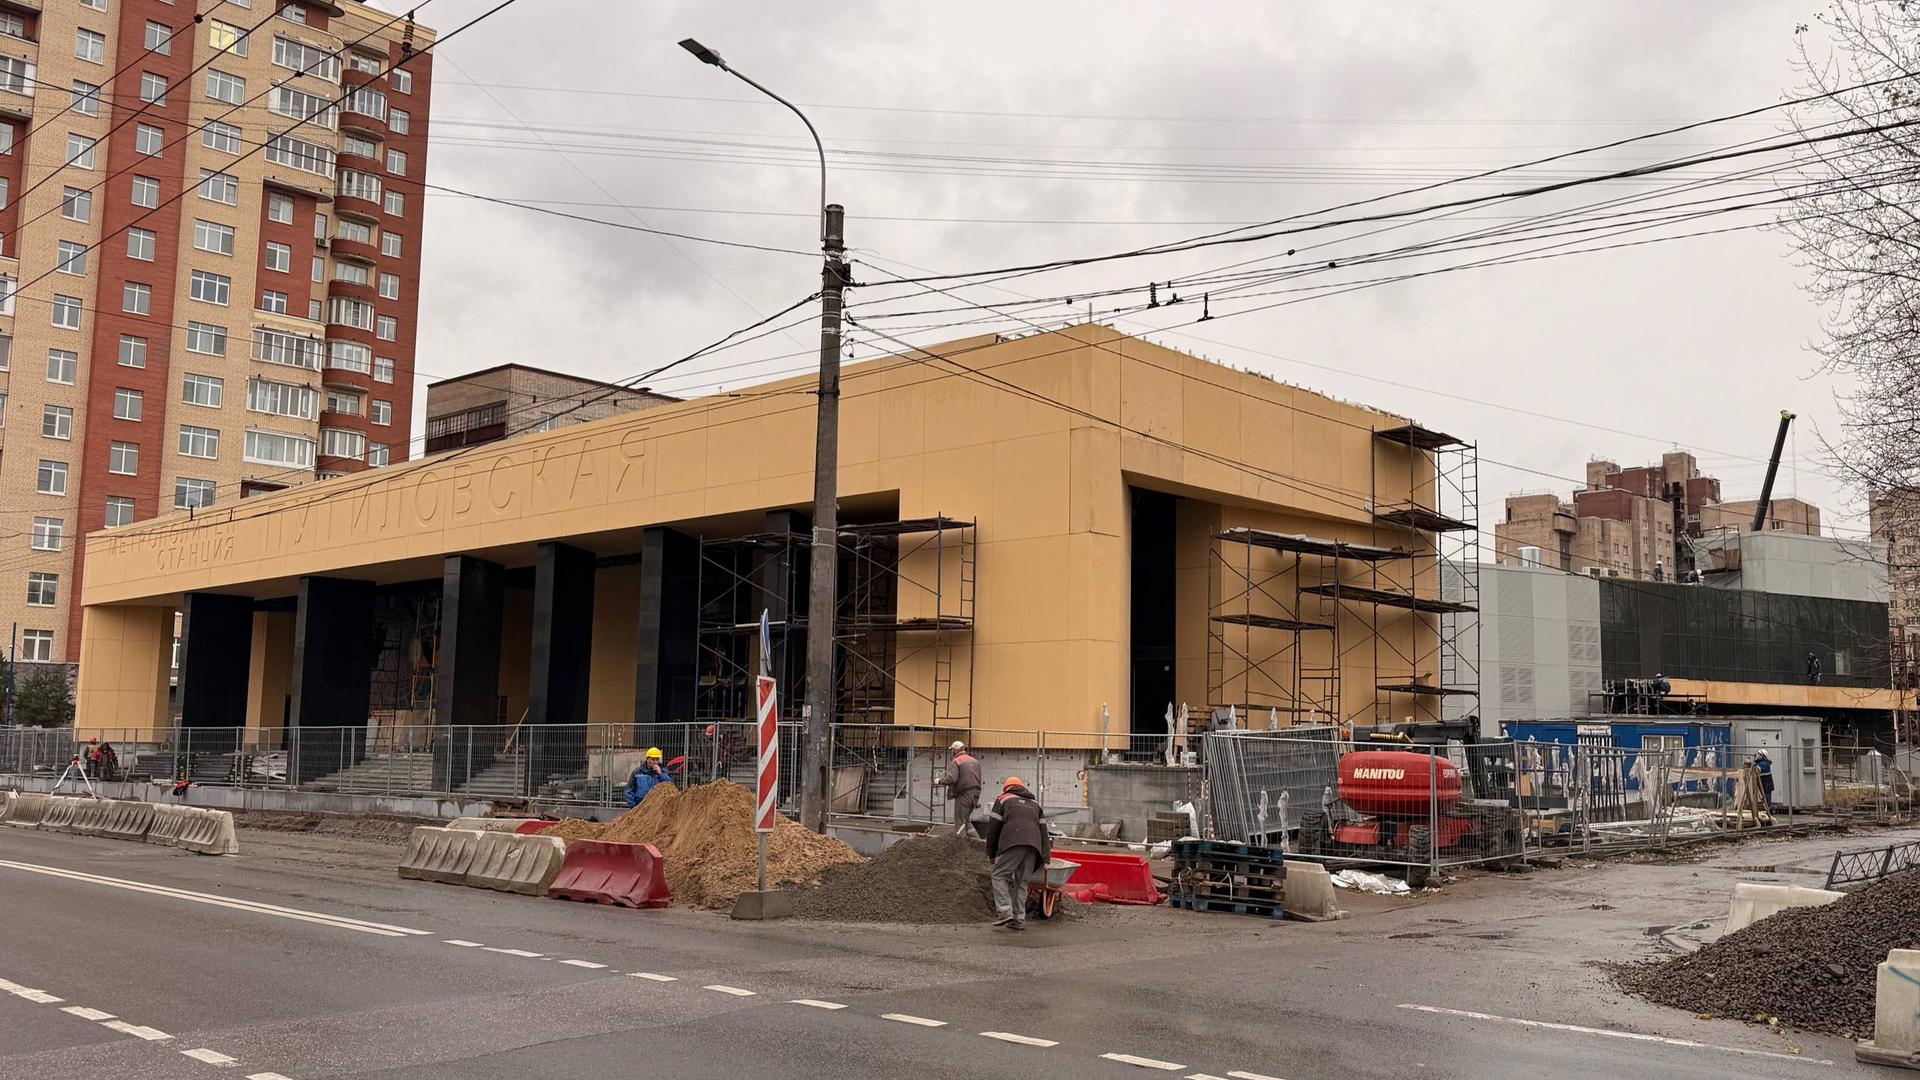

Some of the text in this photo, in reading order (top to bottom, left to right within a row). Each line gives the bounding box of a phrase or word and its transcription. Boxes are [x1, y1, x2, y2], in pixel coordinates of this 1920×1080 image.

[265, 426, 651, 551] ПУТИЛОВСКАЯ
[157, 536, 235, 571] СТАНЦИЯ
[1353, 768, 1405, 780] MANITOU
